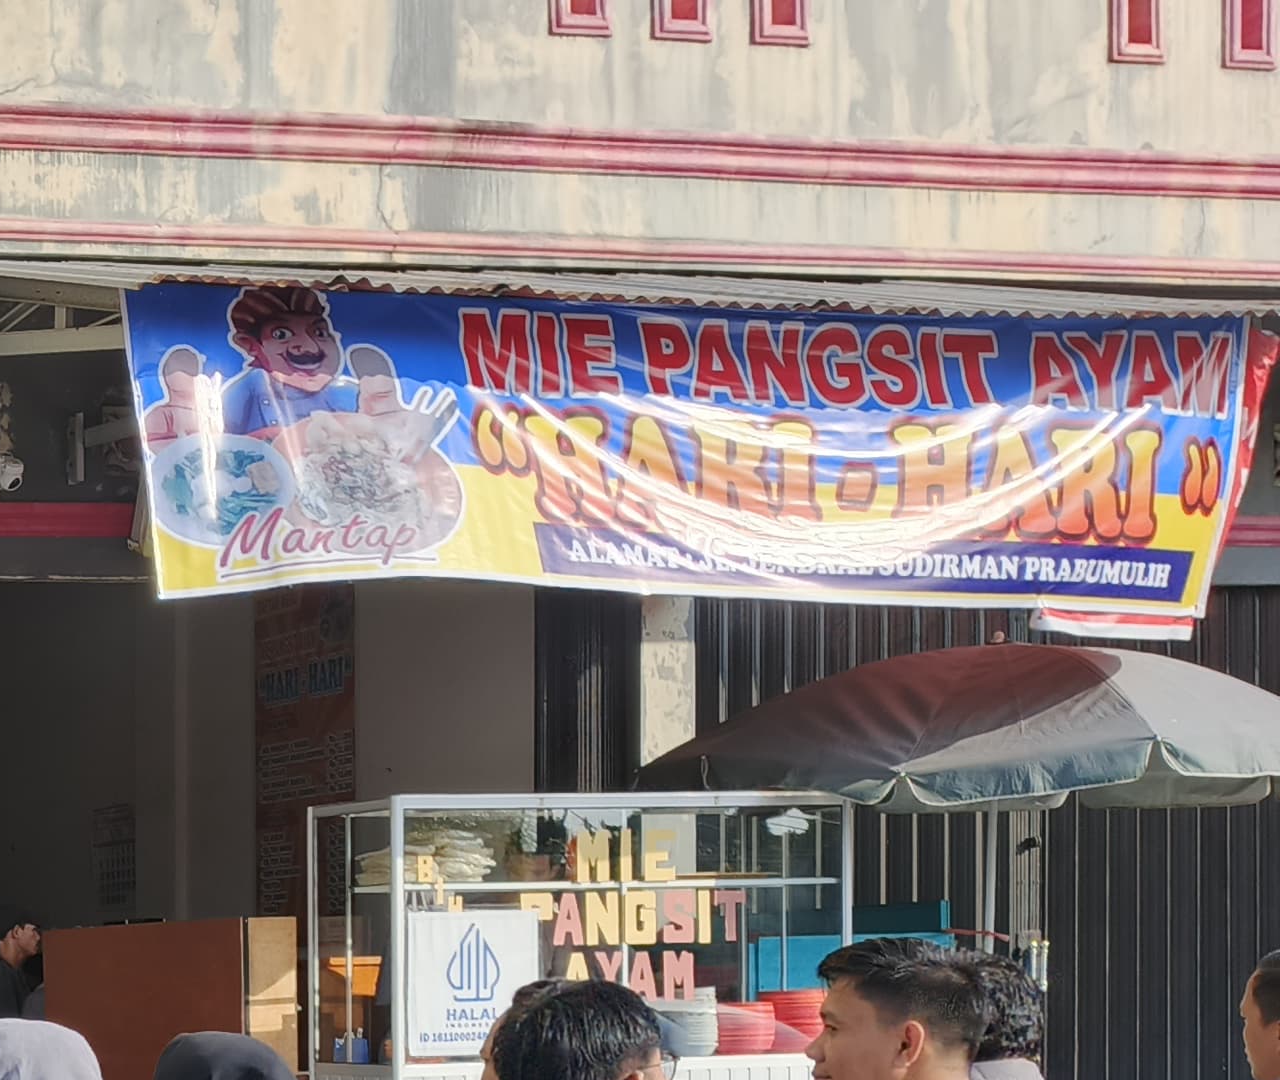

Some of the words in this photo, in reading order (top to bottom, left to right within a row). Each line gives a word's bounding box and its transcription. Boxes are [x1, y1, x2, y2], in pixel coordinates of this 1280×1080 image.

[459, 308, 622, 398] MIE
[638, 317, 998, 410] PANGSIT
[1029, 330, 1233, 420] AYAM
[220, 507, 417, 568] Mantap
[882, 550, 1020, 580] SUDIRMAN
[1026, 556, 1171, 588] PRABUMULIH
[576, 828, 677, 883] MIE
[520, 888, 747, 946] PANGSIT
[566, 950, 695, 1003] AYAM
[419, 1032, 430, 1042] ID
